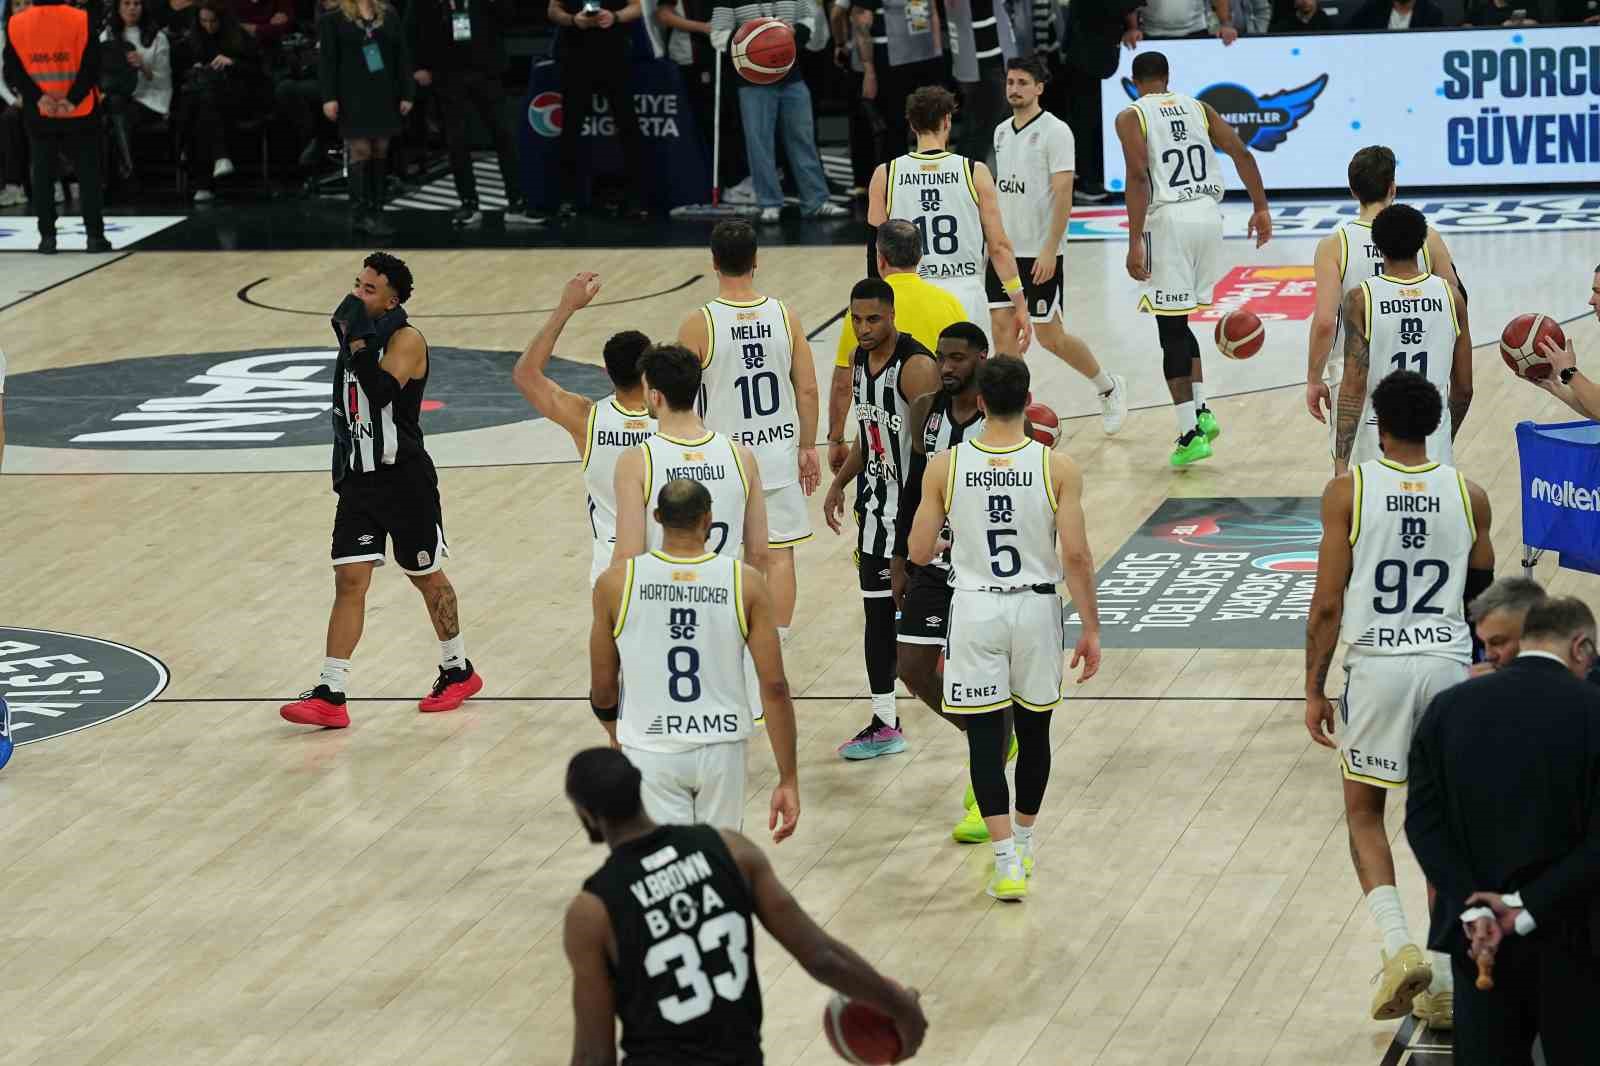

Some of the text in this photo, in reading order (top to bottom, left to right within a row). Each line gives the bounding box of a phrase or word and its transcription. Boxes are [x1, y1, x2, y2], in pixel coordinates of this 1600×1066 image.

[1160, 105, 1188, 117] HALL
[1221, 112, 1281, 124] MENTLER
[1448, 104, 1600, 166] GÜVENİ
[1162, 144, 1207, 187] 20
[898, 172, 959, 185] JANTUNEN
[912, 215, 959, 255] 18
[928, 262, 976, 276] RAMS
[1380, 298, 1442, 314] BOSTON
[731, 321, 771, 340] MELİH
[734, 371, 780, 419] 10
[597, 430, 652, 447] BALDW
[742, 423, 794, 446] RAMS
[966, 468, 1033, 491] EKŞİOĞLU
[1386, 495, 1440, 513] BIRCH
[987, 529, 1021, 577] 5
[640, 584, 728, 605] HORTON-TUCKER
[1130, 552, 1251, 632] BASKETBOL
[1211, 572, 1293, 621] SİGORTA
[1373, 559, 1450, 615] 92
[1379, 626, 1453, 647] RAMS
[667, 646, 701, 703] 8
[0, 641, 104, 732] EŞİK
[966, 685, 997, 698] ENEZ
[667, 714, 738, 734] RAMS
[1367, 756, 1398, 771] ENEZ
[629, 851, 712, 908] V.BROWN
[644, 911, 749, 1025] 33
